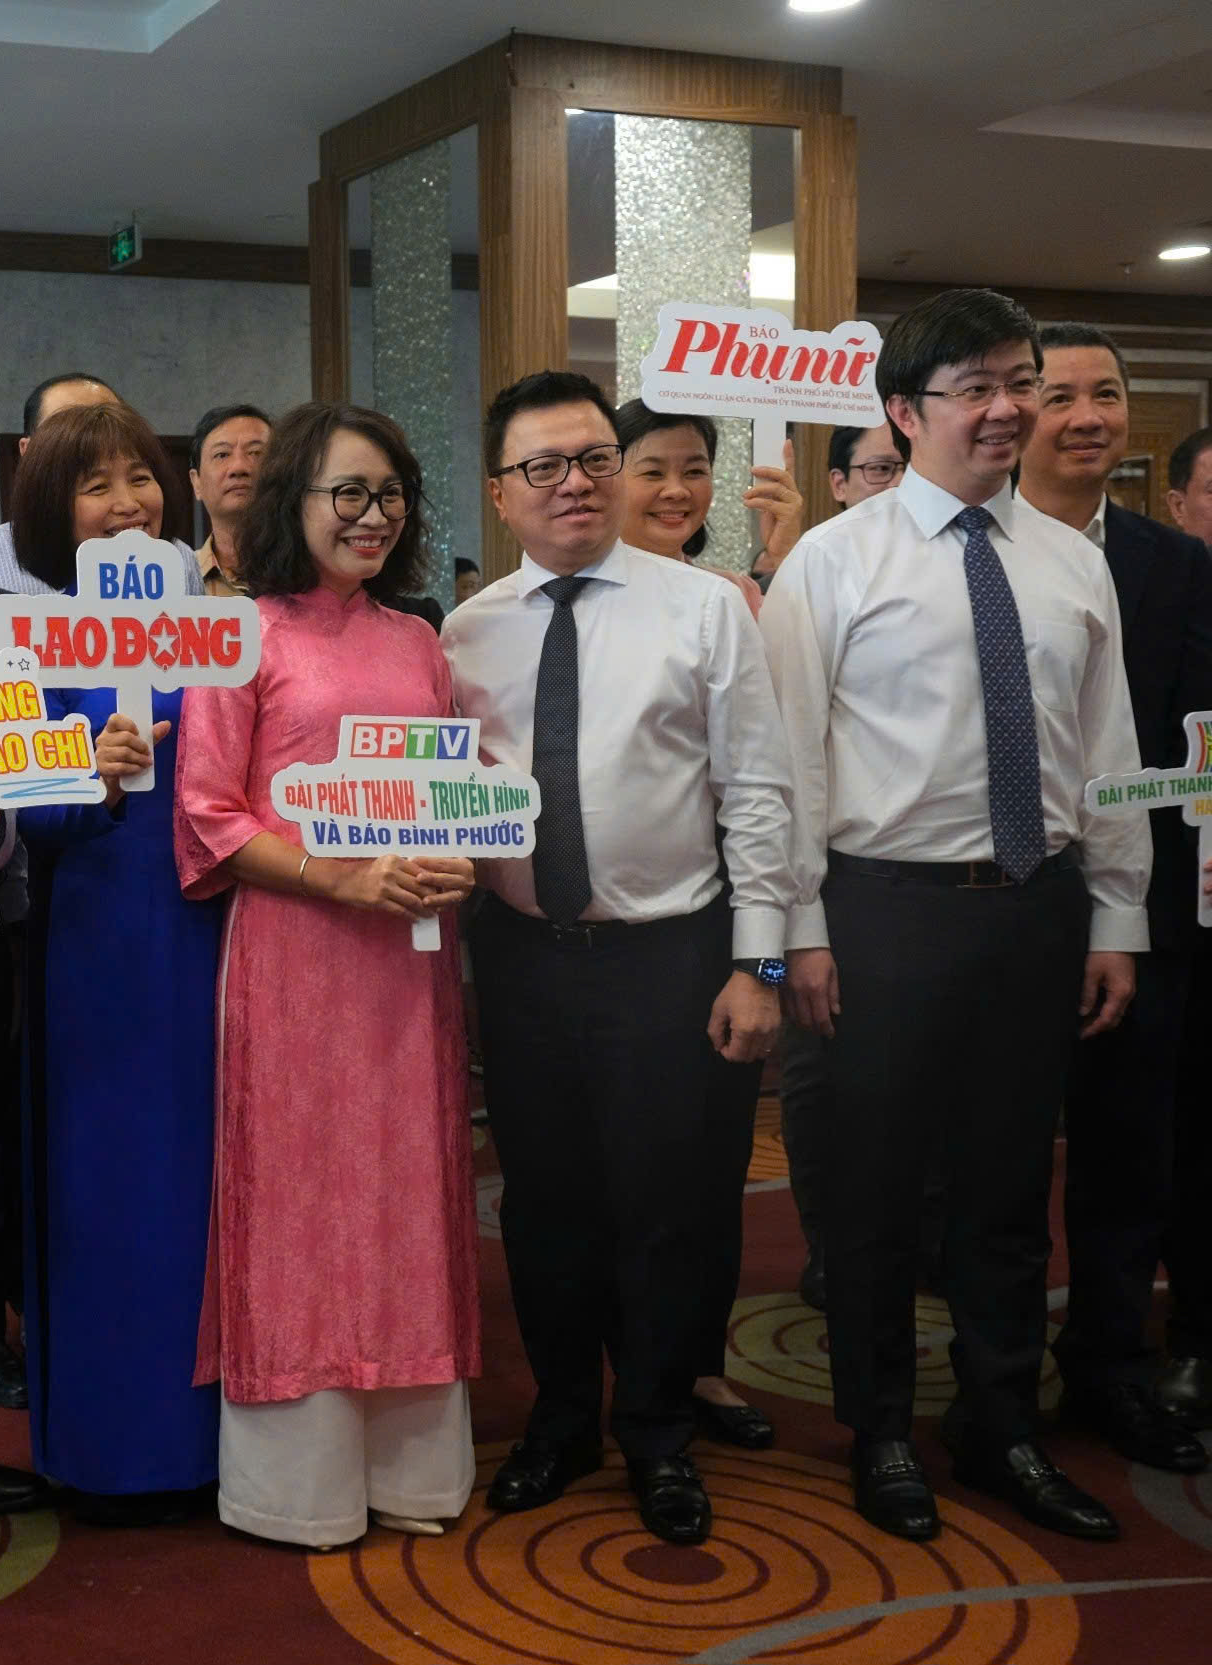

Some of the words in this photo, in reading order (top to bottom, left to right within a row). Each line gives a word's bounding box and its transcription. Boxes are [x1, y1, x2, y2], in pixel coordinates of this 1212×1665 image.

[749, 324, 780, 340] BÁO
[851, 391, 874, 401] MINH
[98, 555, 165, 600] BÁO
[11, 616, 108, 669] LAO
[33, 722, 91, 769] CHÍ
[351, 724, 469, 758] BPTV
[284, 779, 313, 810] ĐÀI
[316, 772, 358, 817] PHÁT
[361, 779, 417, 821] THANH
[429, 771, 491, 821] TRUYỀN
[493, 780, 530, 814] HÌNH
[1097, 784, 1123, 806] ĐÀI
[1127, 778, 1166, 801] PHÁT
[312, 818, 342, 845] VÀ
[348, 822, 392, 845] BÁO
[398, 824, 450, 846] BÌNH
[455, 820, 525, 846] PHƯỚC
